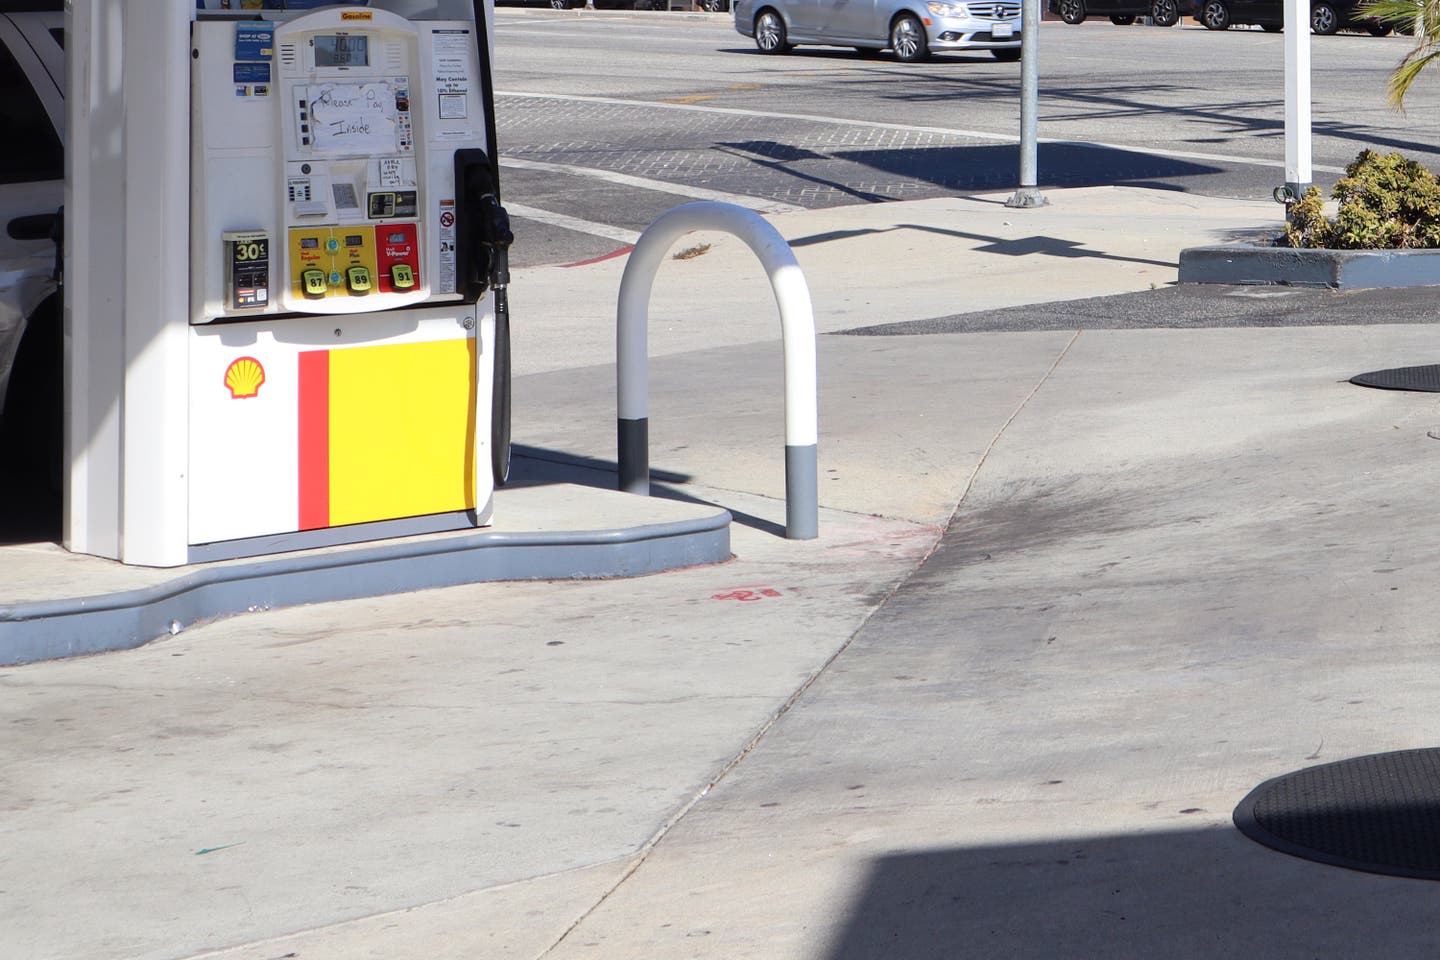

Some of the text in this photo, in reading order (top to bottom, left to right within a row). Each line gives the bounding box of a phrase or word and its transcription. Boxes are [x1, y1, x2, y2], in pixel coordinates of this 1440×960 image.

[342, 13, 371, 21] Gasoline
[309, 39, 314, 47] $
[320, 89, 383, 112] Please Pay
[329, 116, 371, 137] Inside
[355, 275, 367, 284] 89
[398, 272, 410, 282] 91
[310, 278, 322, 288] 87
